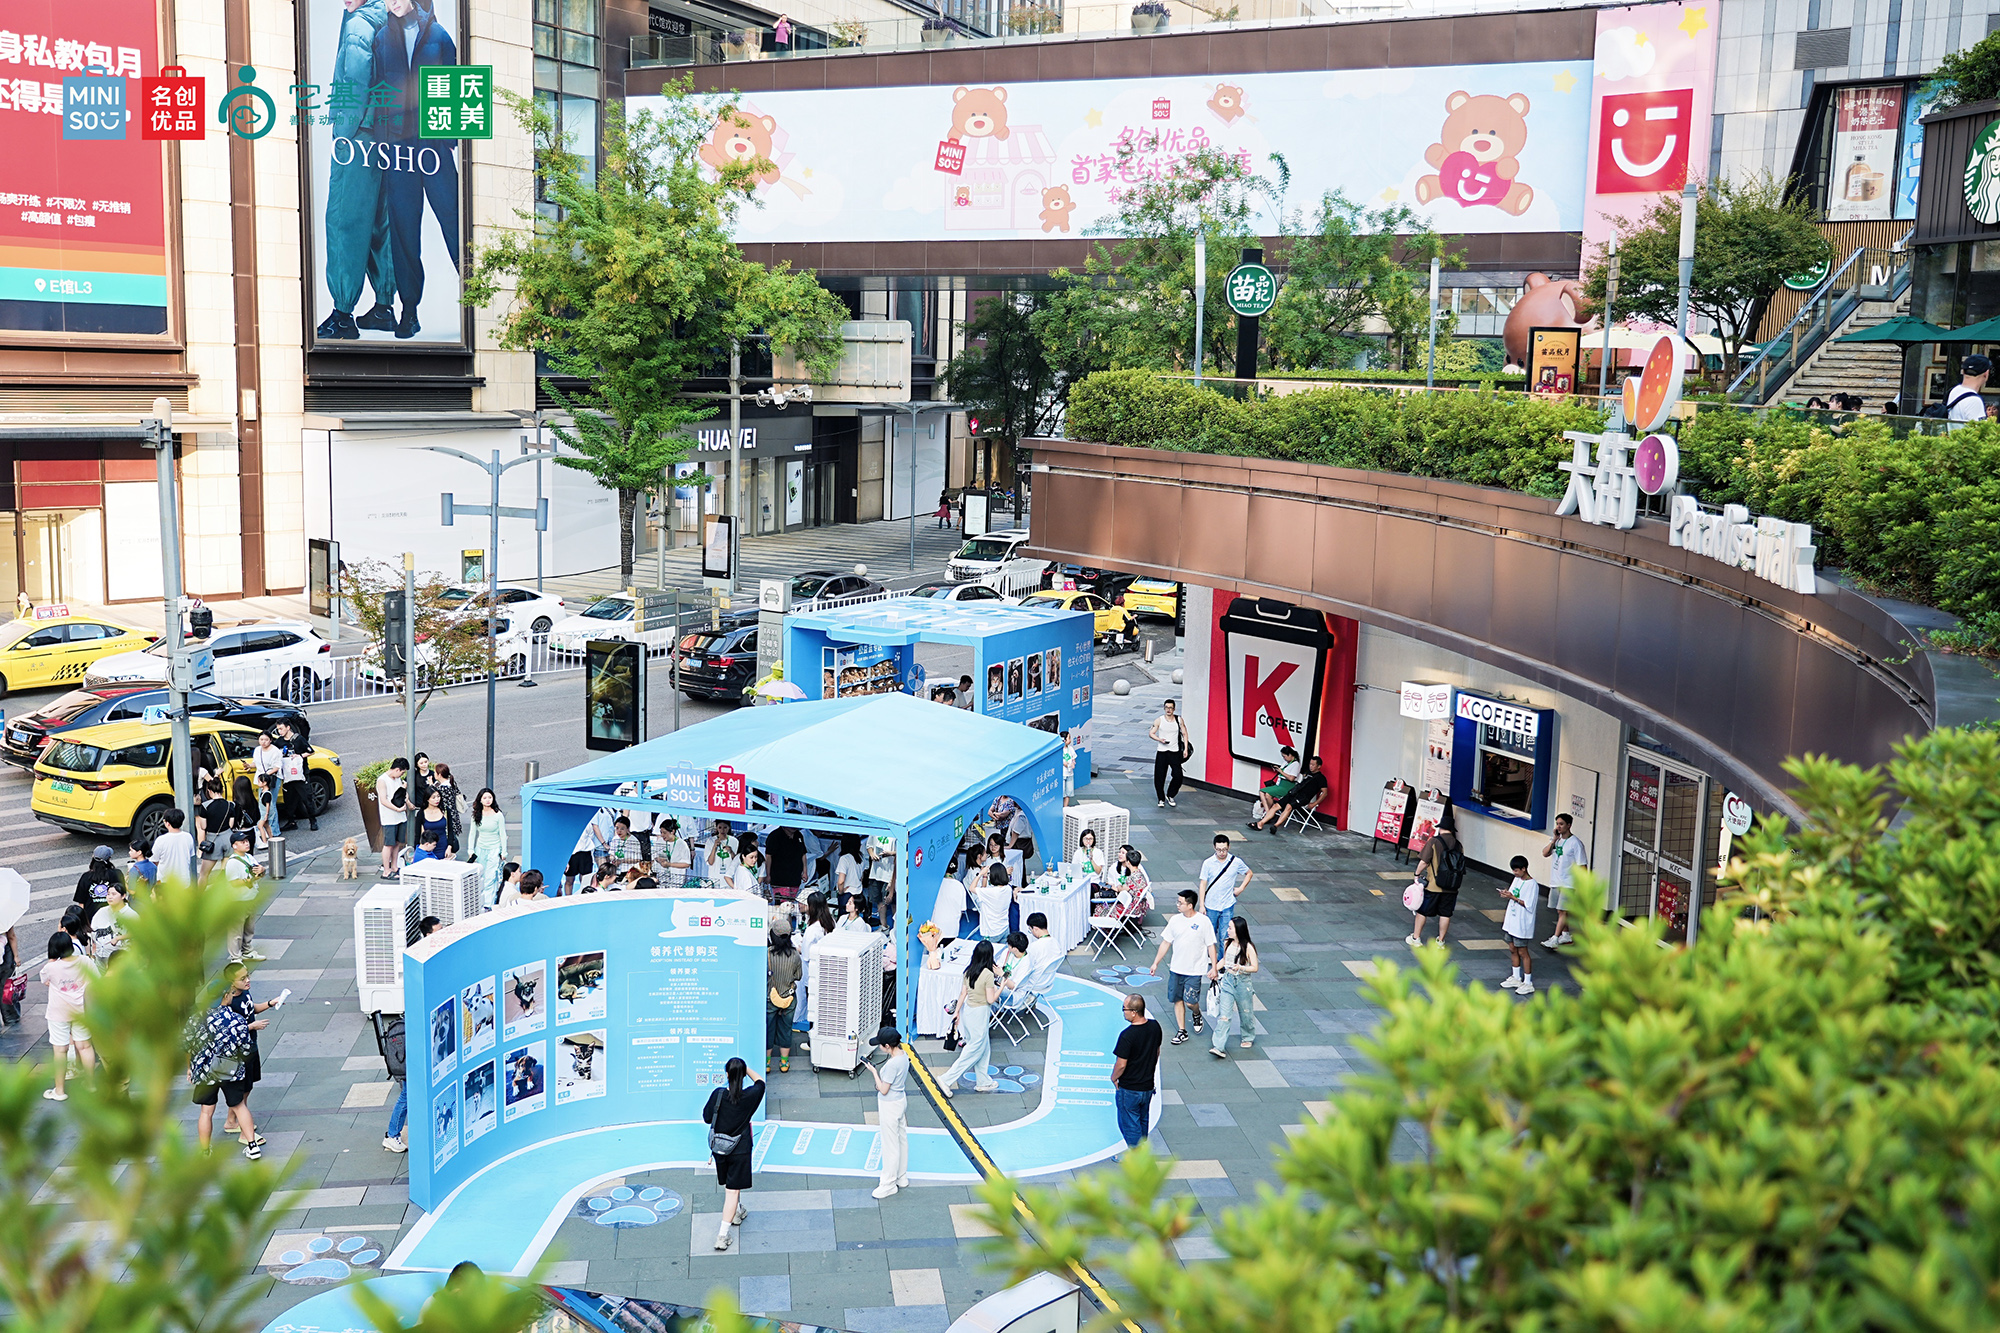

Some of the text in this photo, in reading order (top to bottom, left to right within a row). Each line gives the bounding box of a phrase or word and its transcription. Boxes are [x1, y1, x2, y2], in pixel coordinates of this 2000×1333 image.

[1153, 102, 1170, 110] MINI
[1850, 116, 1887, 126] 奶茶巴士
[331, 136, 441, 176] OYSHO
[940, 143, 964, 161] MINI
[50, 279, 92, 295] E馆L3
[1669, 495, 1757, 571] Paradise
[763, 627, 778, 636] TAXI
[1258, 713, 1303, 735] COFFEE
[670, 773, 701, 788] MINI
[712, 776, 741, 793] 名创
[712, 793, 741, 809] 优品
[1633, 846, 1645, 858] KFC
[1669, 863, 1682, 875] KFC
[650, 945, 718, 957] 领养代替购买
[669, 967, 698, 975] 领养要求
